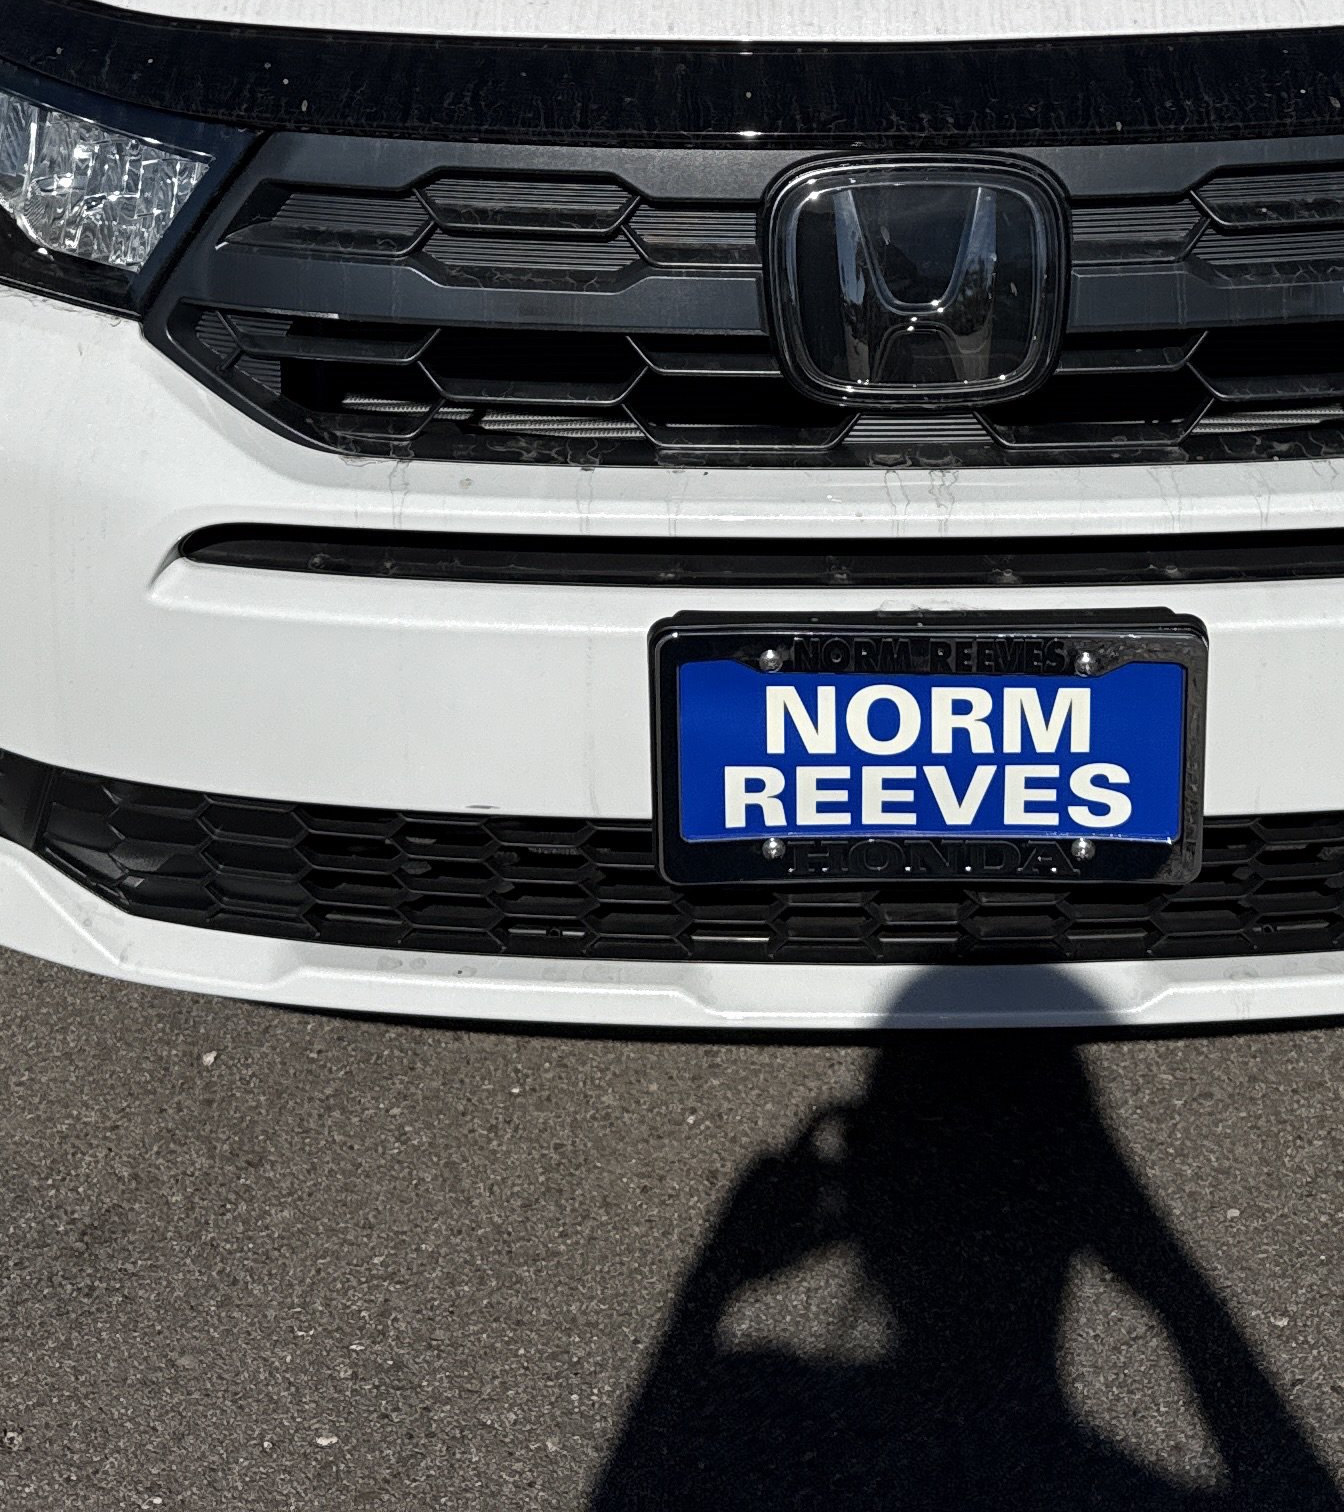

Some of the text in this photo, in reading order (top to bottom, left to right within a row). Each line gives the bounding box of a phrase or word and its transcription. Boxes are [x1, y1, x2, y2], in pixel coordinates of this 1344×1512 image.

[793, 637, 1068, 675] NORM REEVES
[766, 685, 1091, 756] NORM
[724, 763, 1132, 830] REEVES
[787, 839, 1081, 875] HONDA
